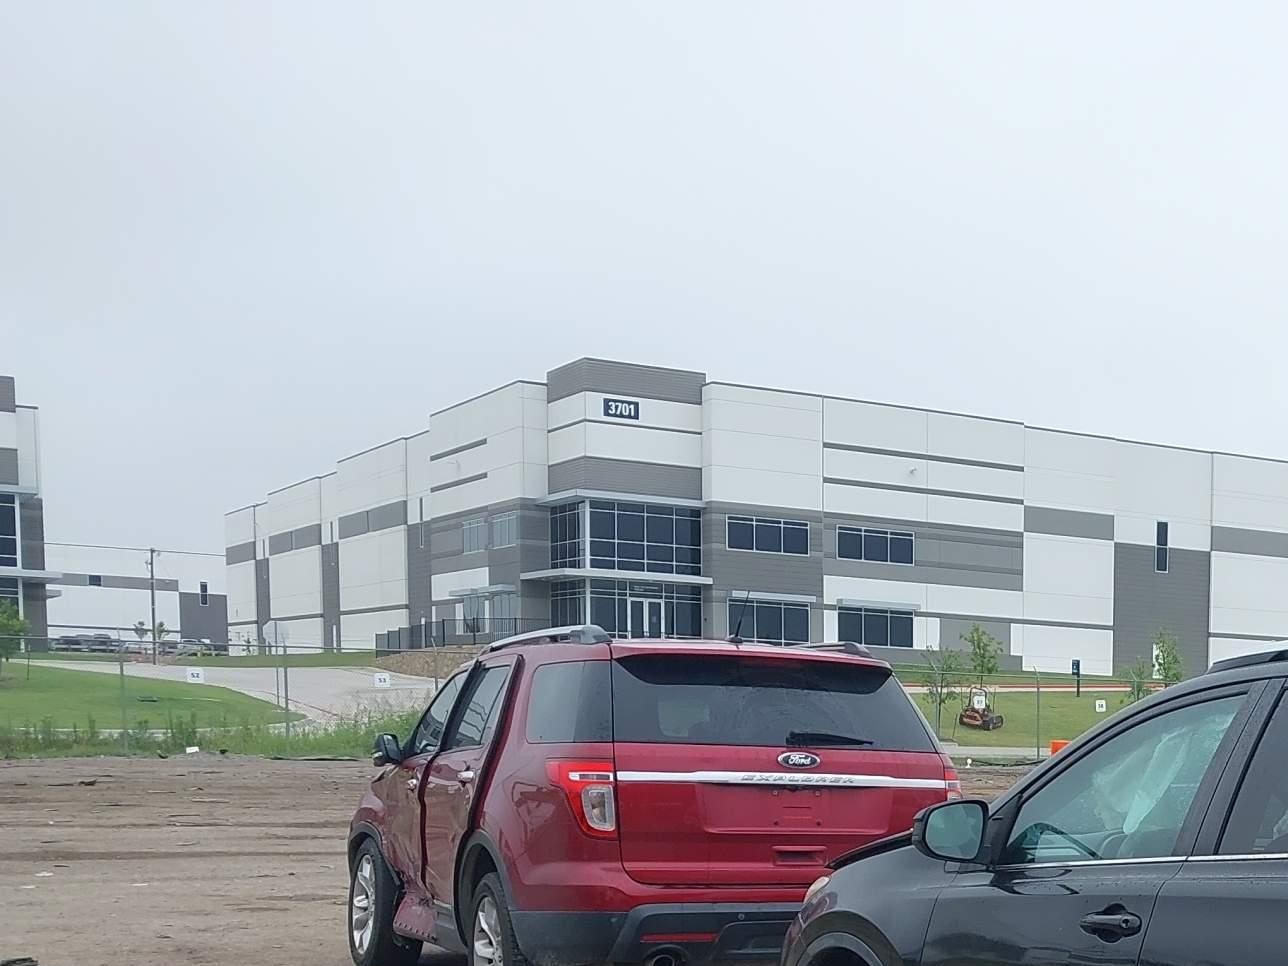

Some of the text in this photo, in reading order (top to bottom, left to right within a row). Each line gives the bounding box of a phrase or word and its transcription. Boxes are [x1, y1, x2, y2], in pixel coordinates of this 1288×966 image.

[608, 401, 635, 417] 3701
[788, 754, 812, 765] Ford
[741, 774, 855, 784] EXPLORER
